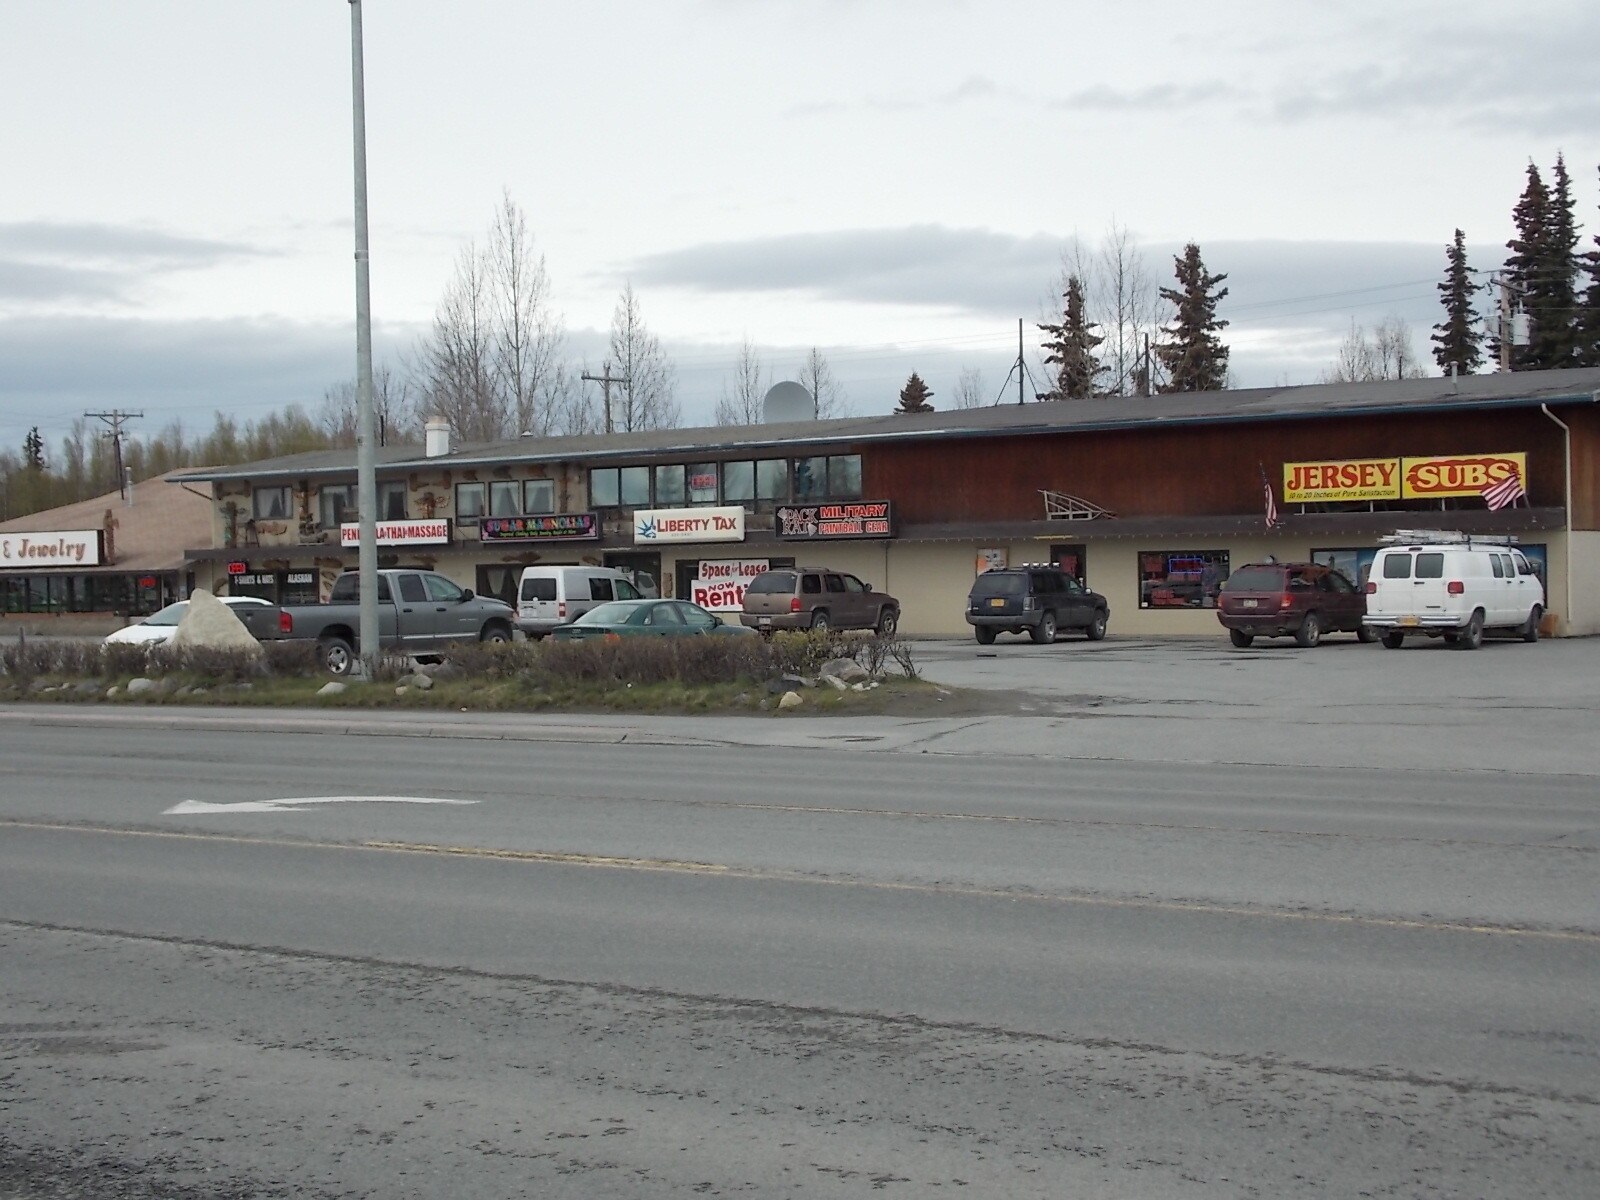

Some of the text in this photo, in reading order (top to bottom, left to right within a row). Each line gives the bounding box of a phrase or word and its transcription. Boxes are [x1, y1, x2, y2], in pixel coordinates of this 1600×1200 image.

[1287, 461, 1511, 491] JERSEY SUBS
[1304, 491, 1312, 499] 20
[1358, 489, 1395, 497] Satisfaction
[786, 508, 818, 524] PACK
[819, 505, 887, 518] MILITARY
[486, 515, 591, 533] SUGAR MAGNOLIAS
[656, 515, 737, 533] LIBERTY TAX
[782, 520, 811, 535] RAT
[818, 520, 888, 535] PAINTBALL GEAR
[342, 527, 384, 541] PENILA
[407, 524, 447, 538] MASSAGE
[18, 539, 86, 562] Jewelry
[701, 562, 731, 580] Space
[738, 561, 767, 577] Lease
[708, 581, 735, 592] NOW
